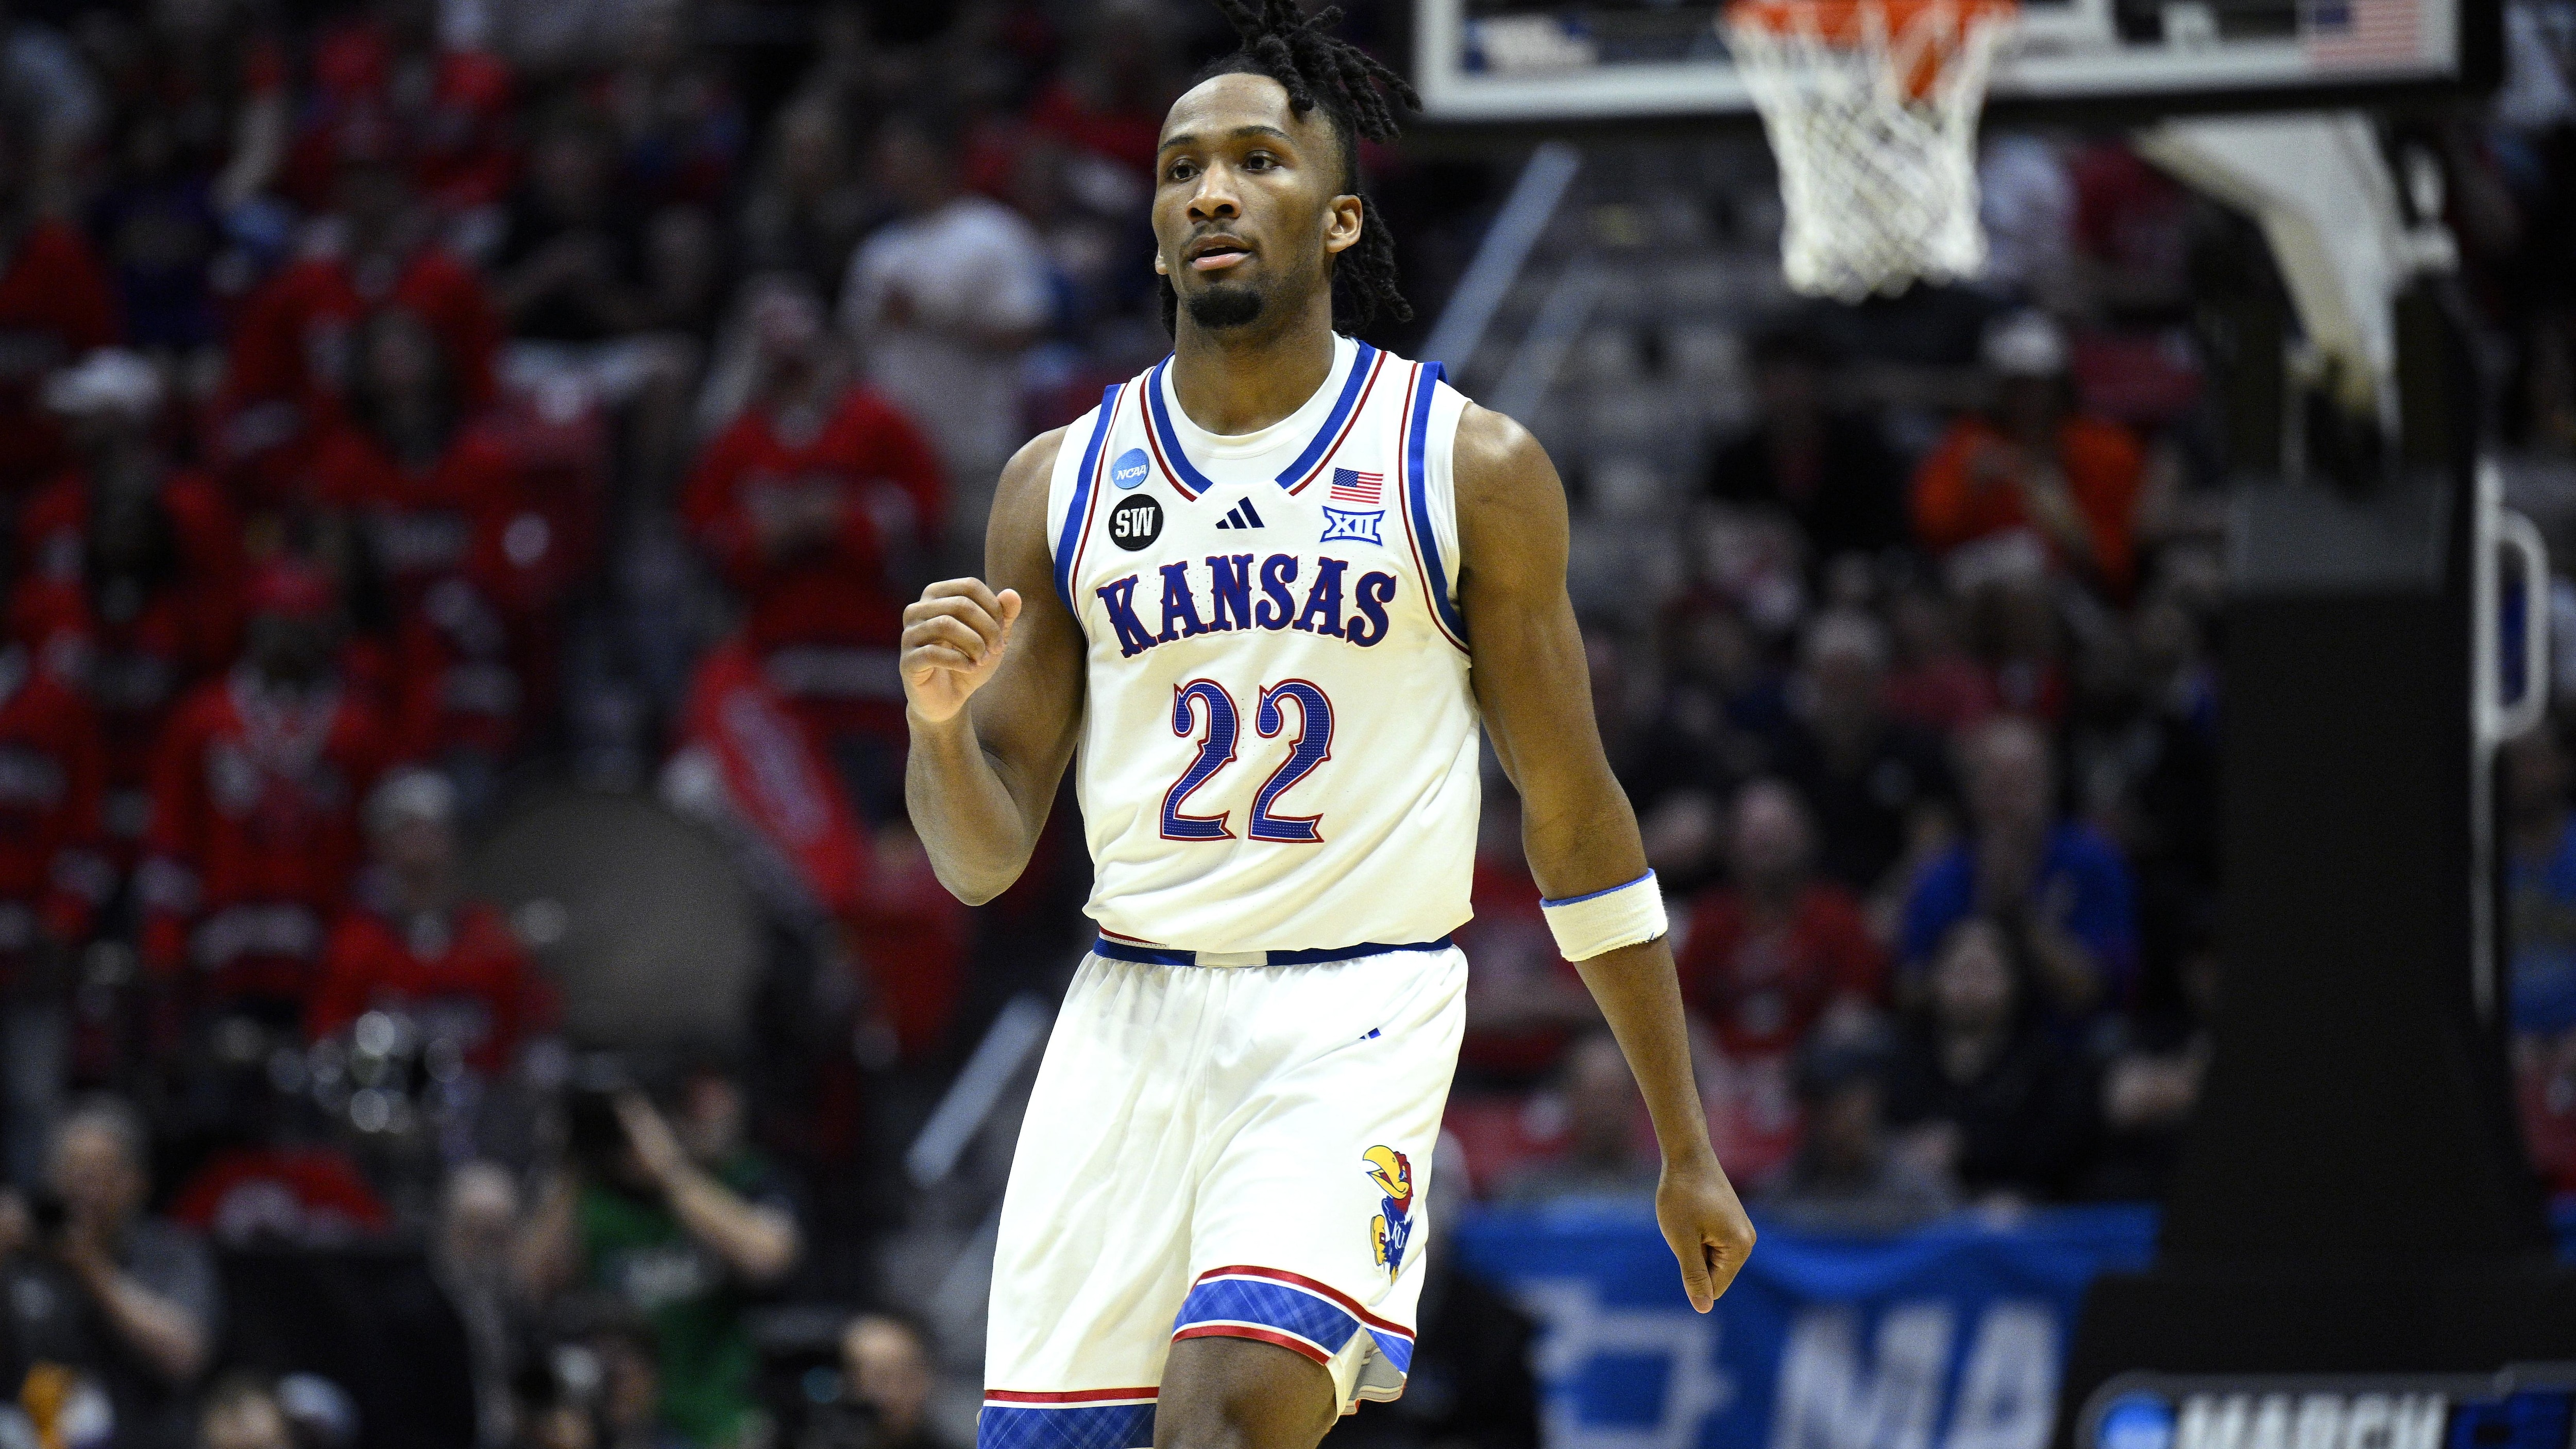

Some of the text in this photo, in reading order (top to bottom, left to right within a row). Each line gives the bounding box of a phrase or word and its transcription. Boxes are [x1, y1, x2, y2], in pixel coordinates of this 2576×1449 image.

[1116, 464, 1147, 481] NCAA
[1115, 506, 1156, 538] SW
[1096, 554, 1397, 659] KANSAS
[1160, 678, 1335, 843] 22
